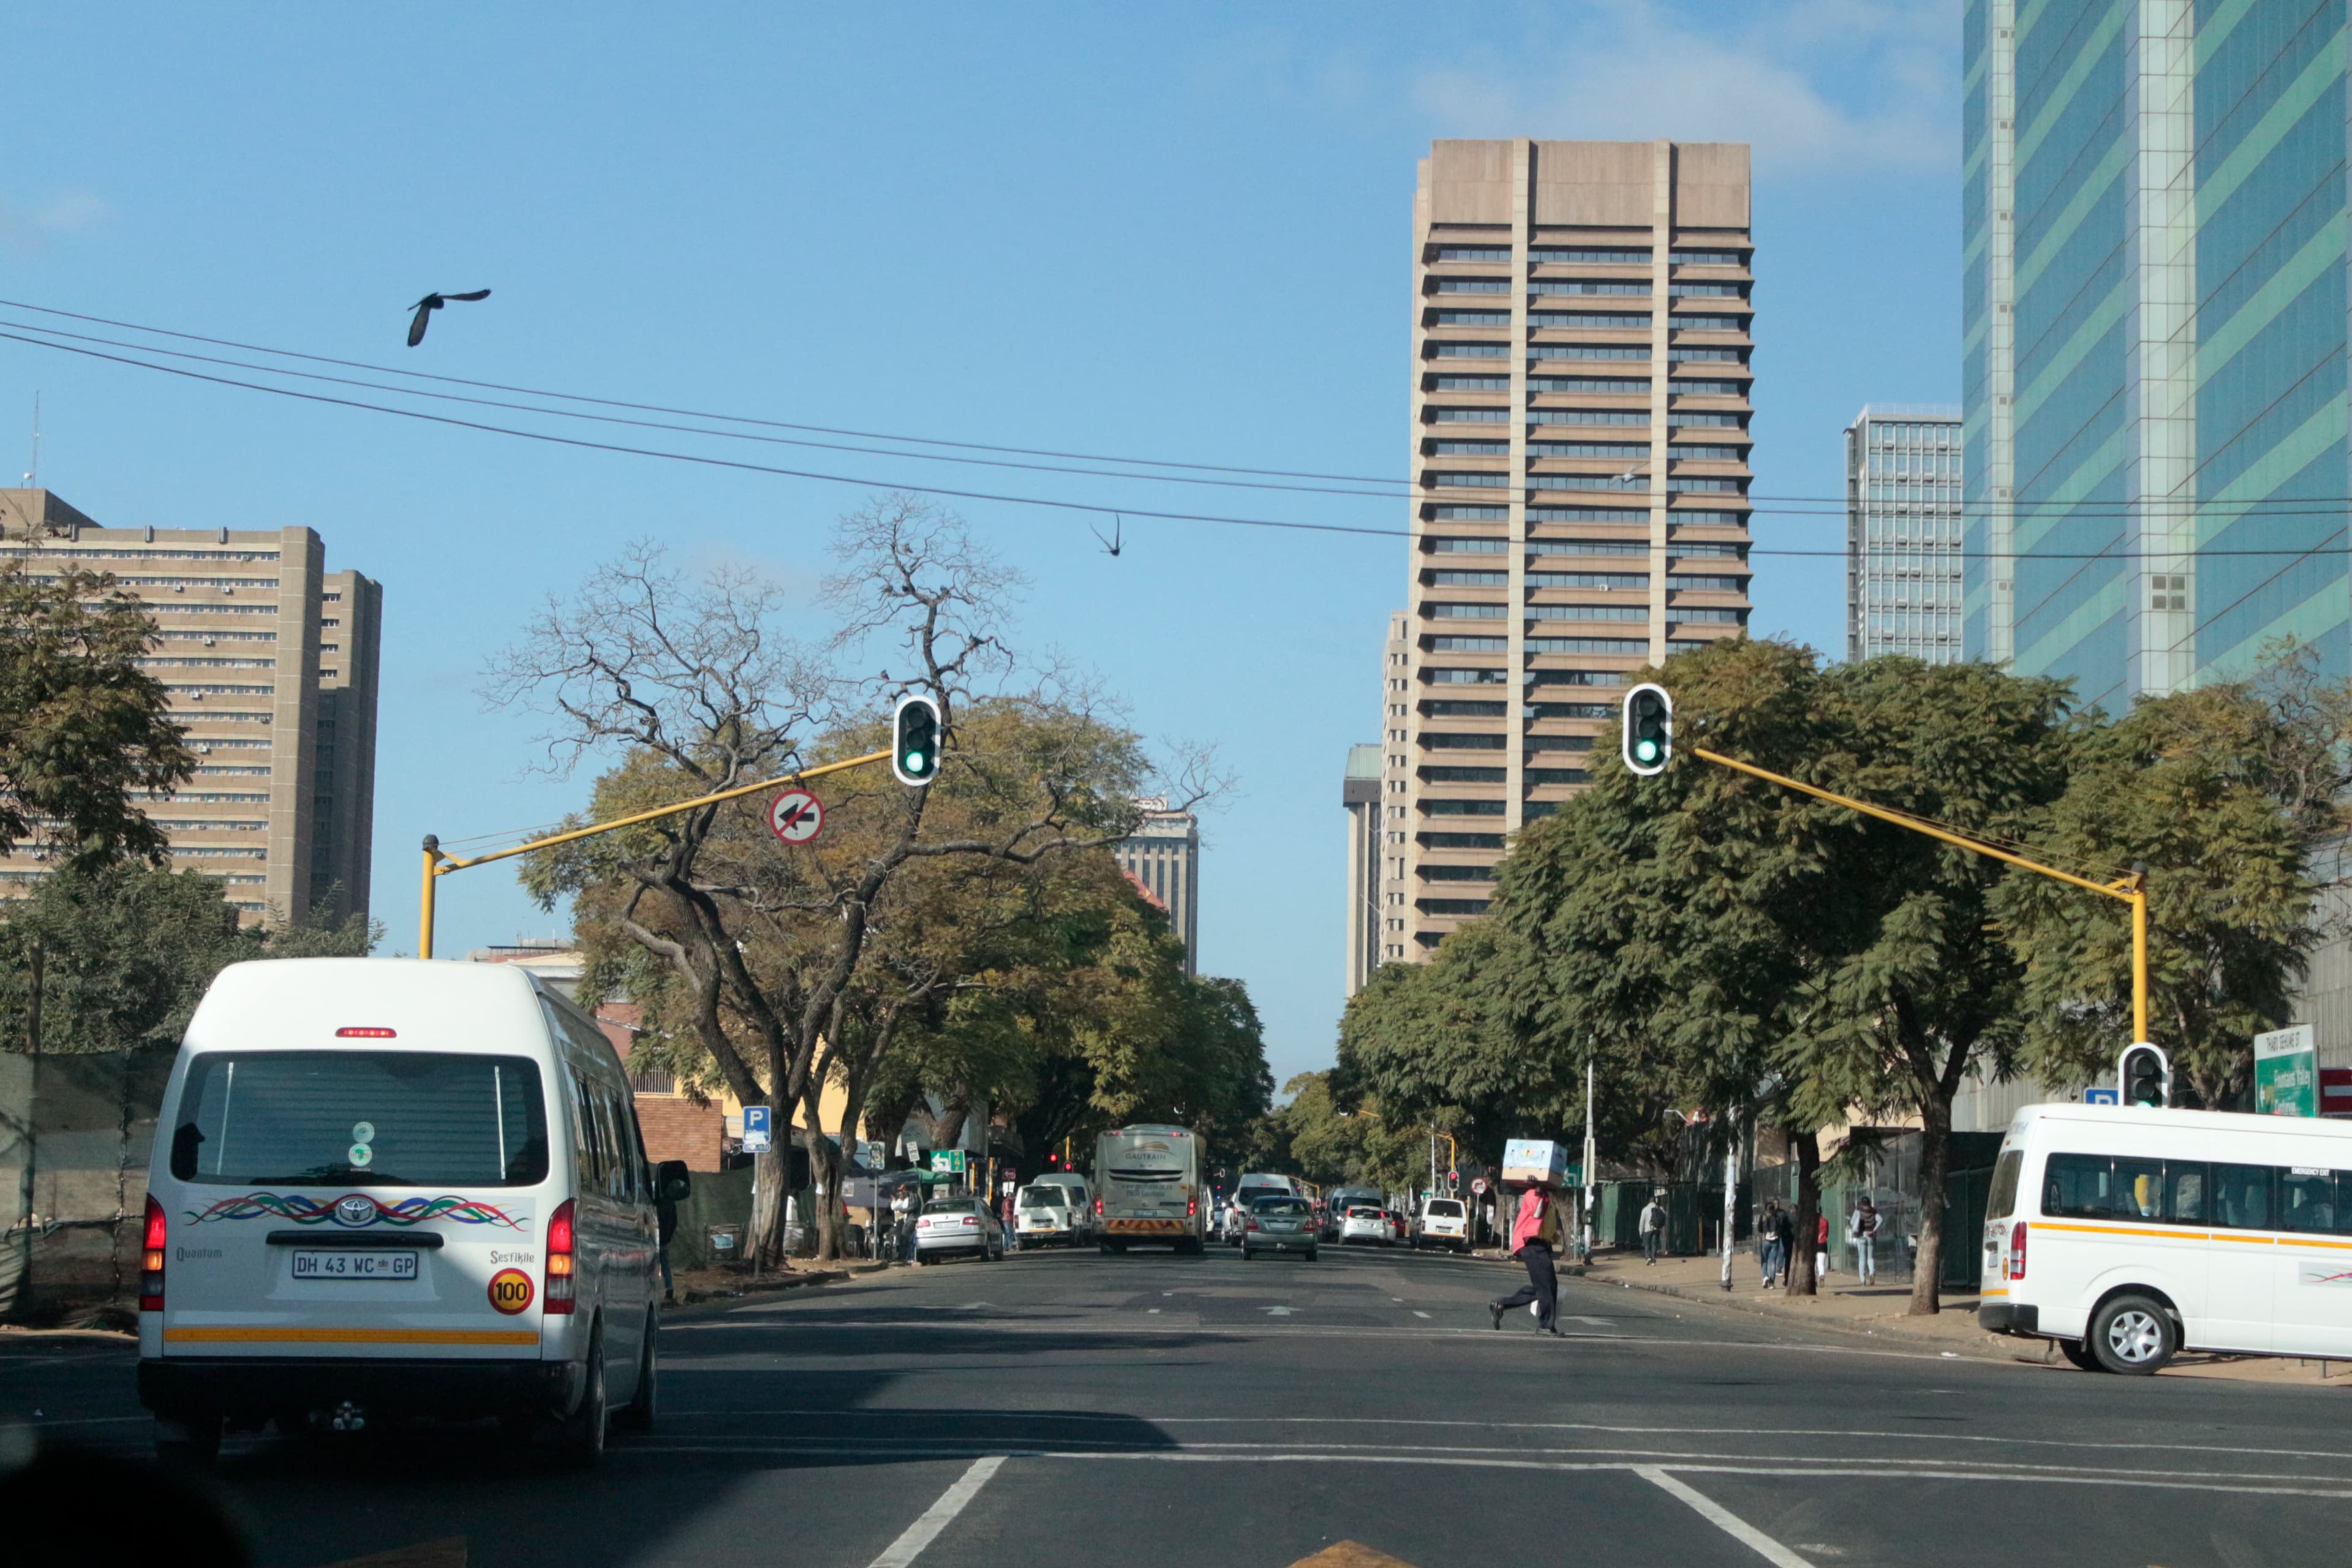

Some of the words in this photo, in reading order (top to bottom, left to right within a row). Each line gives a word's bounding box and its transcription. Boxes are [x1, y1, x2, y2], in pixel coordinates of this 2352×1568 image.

[750, 1110, 763, 1126] P
[2291, 1166, 2319, 1176] EMERGENCY
[176, 1247, 222, 1262] Quantum
[296, 1257, 317, 1273] DH
[325, 1257, 345, 1273] 43
[354, 1258, 374, 1273] WC
[393, 1258, 413, 1273] GP
[496, 1282, 527, 1301] 100
